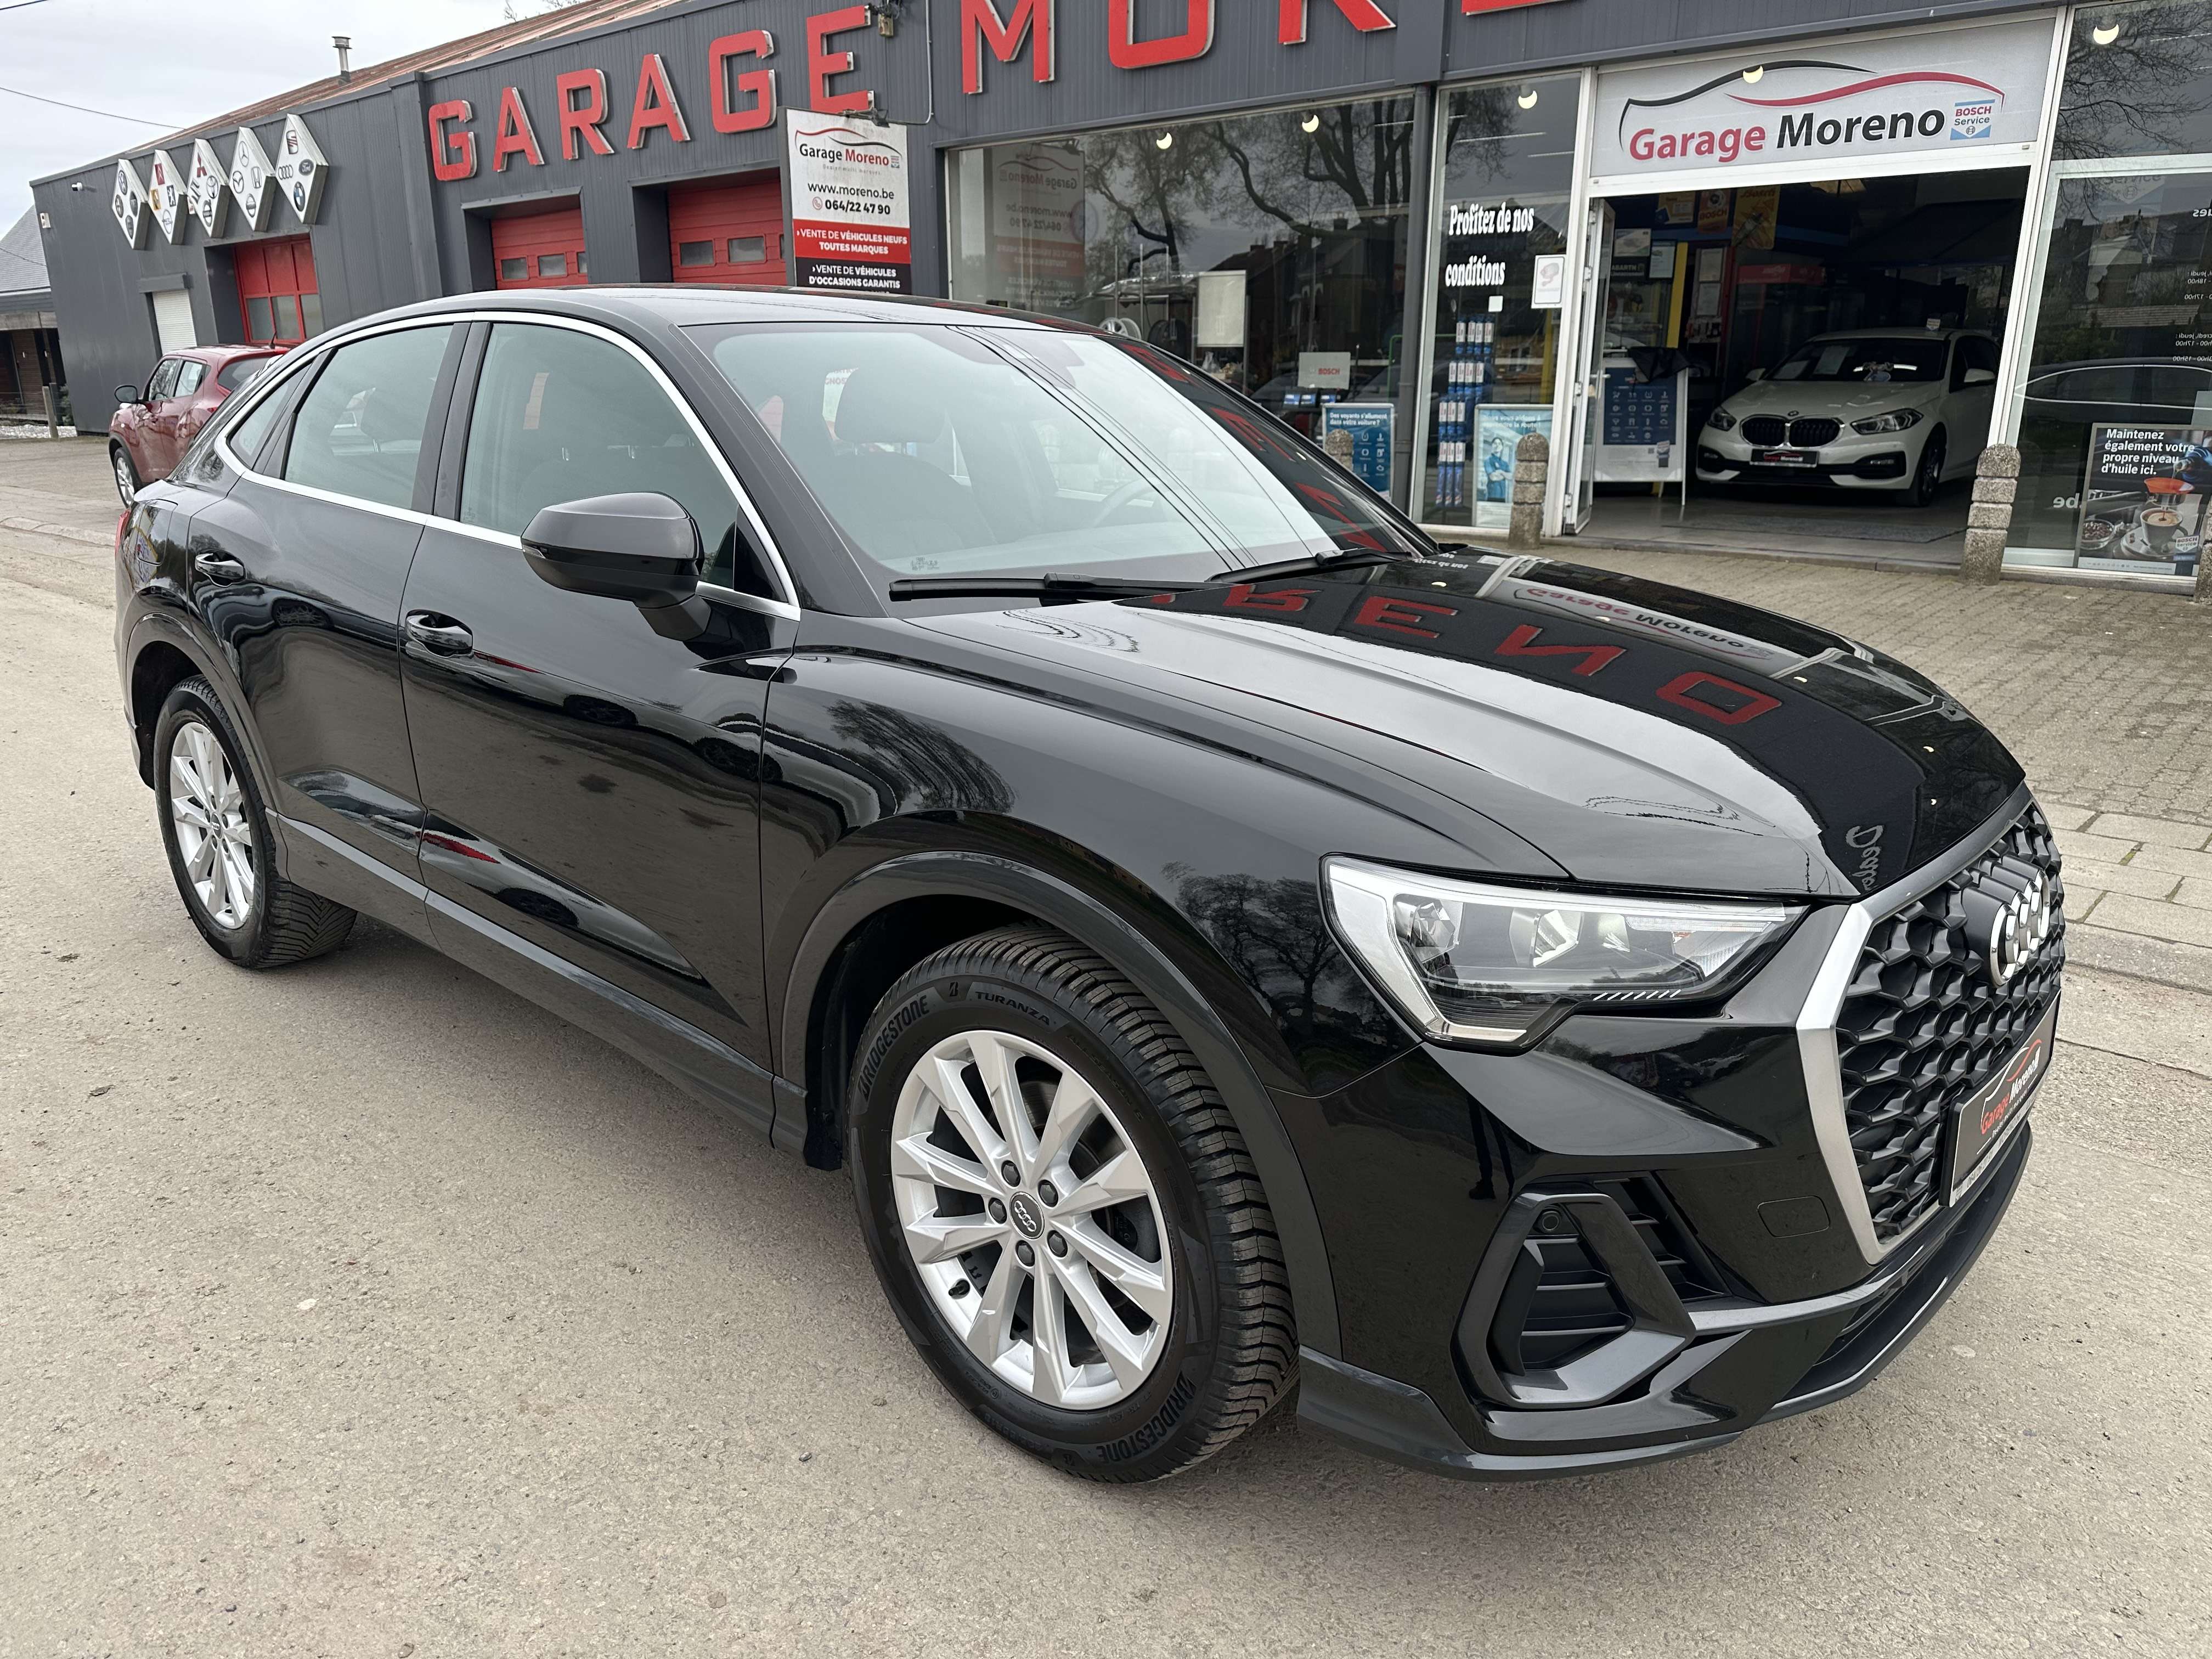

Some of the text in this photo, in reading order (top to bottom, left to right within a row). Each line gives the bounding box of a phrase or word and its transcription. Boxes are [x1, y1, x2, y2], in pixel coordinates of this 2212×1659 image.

[428, 5, 874, 181] GARAGE
[1955, 104, 1992, 117] BOSCH
[1953, 115, 1990, 126] Service
[1629, 108, 1946, 163] Garage Moreno
[800, 143, 843, 163] Garage
[845, 149, 889, 166] Moreno
[808, 183, 895, 200] www.moreno.be
[825, 200, 890, 215] 064/22 47 90
[1448, 201, 1534, 235] Profitez de nos
[800, 229, 908, 244] VENTE DE VÉHICULES NEUFS
[819, 242, 889, 255] TOUTES MARQUES
[816, 264, 896, 278] VENTE DE VÉHICULES
[1445, 255, 1506, 286] conditions
[809, 276, 900, 289] D'OCCASIONS GARANTIS
[2107, 428, 2164, 439] Maintenez
[2104, 440, 2194, 452] également votre
[2103, 453, 2179, 464] propre niveau
[2101, 463, 2157, 475] d'huile ici.
[974, 990, 1052, 1027] TURANZA
[857, 994, 930, 1103] BRIDGESTONE
[1981, 1092, 2011, 1135] Garage
[2009, 1062, 2036, 1104] Moreno
[1097, 1378, 1195, 1463] BRIDGESTONE
